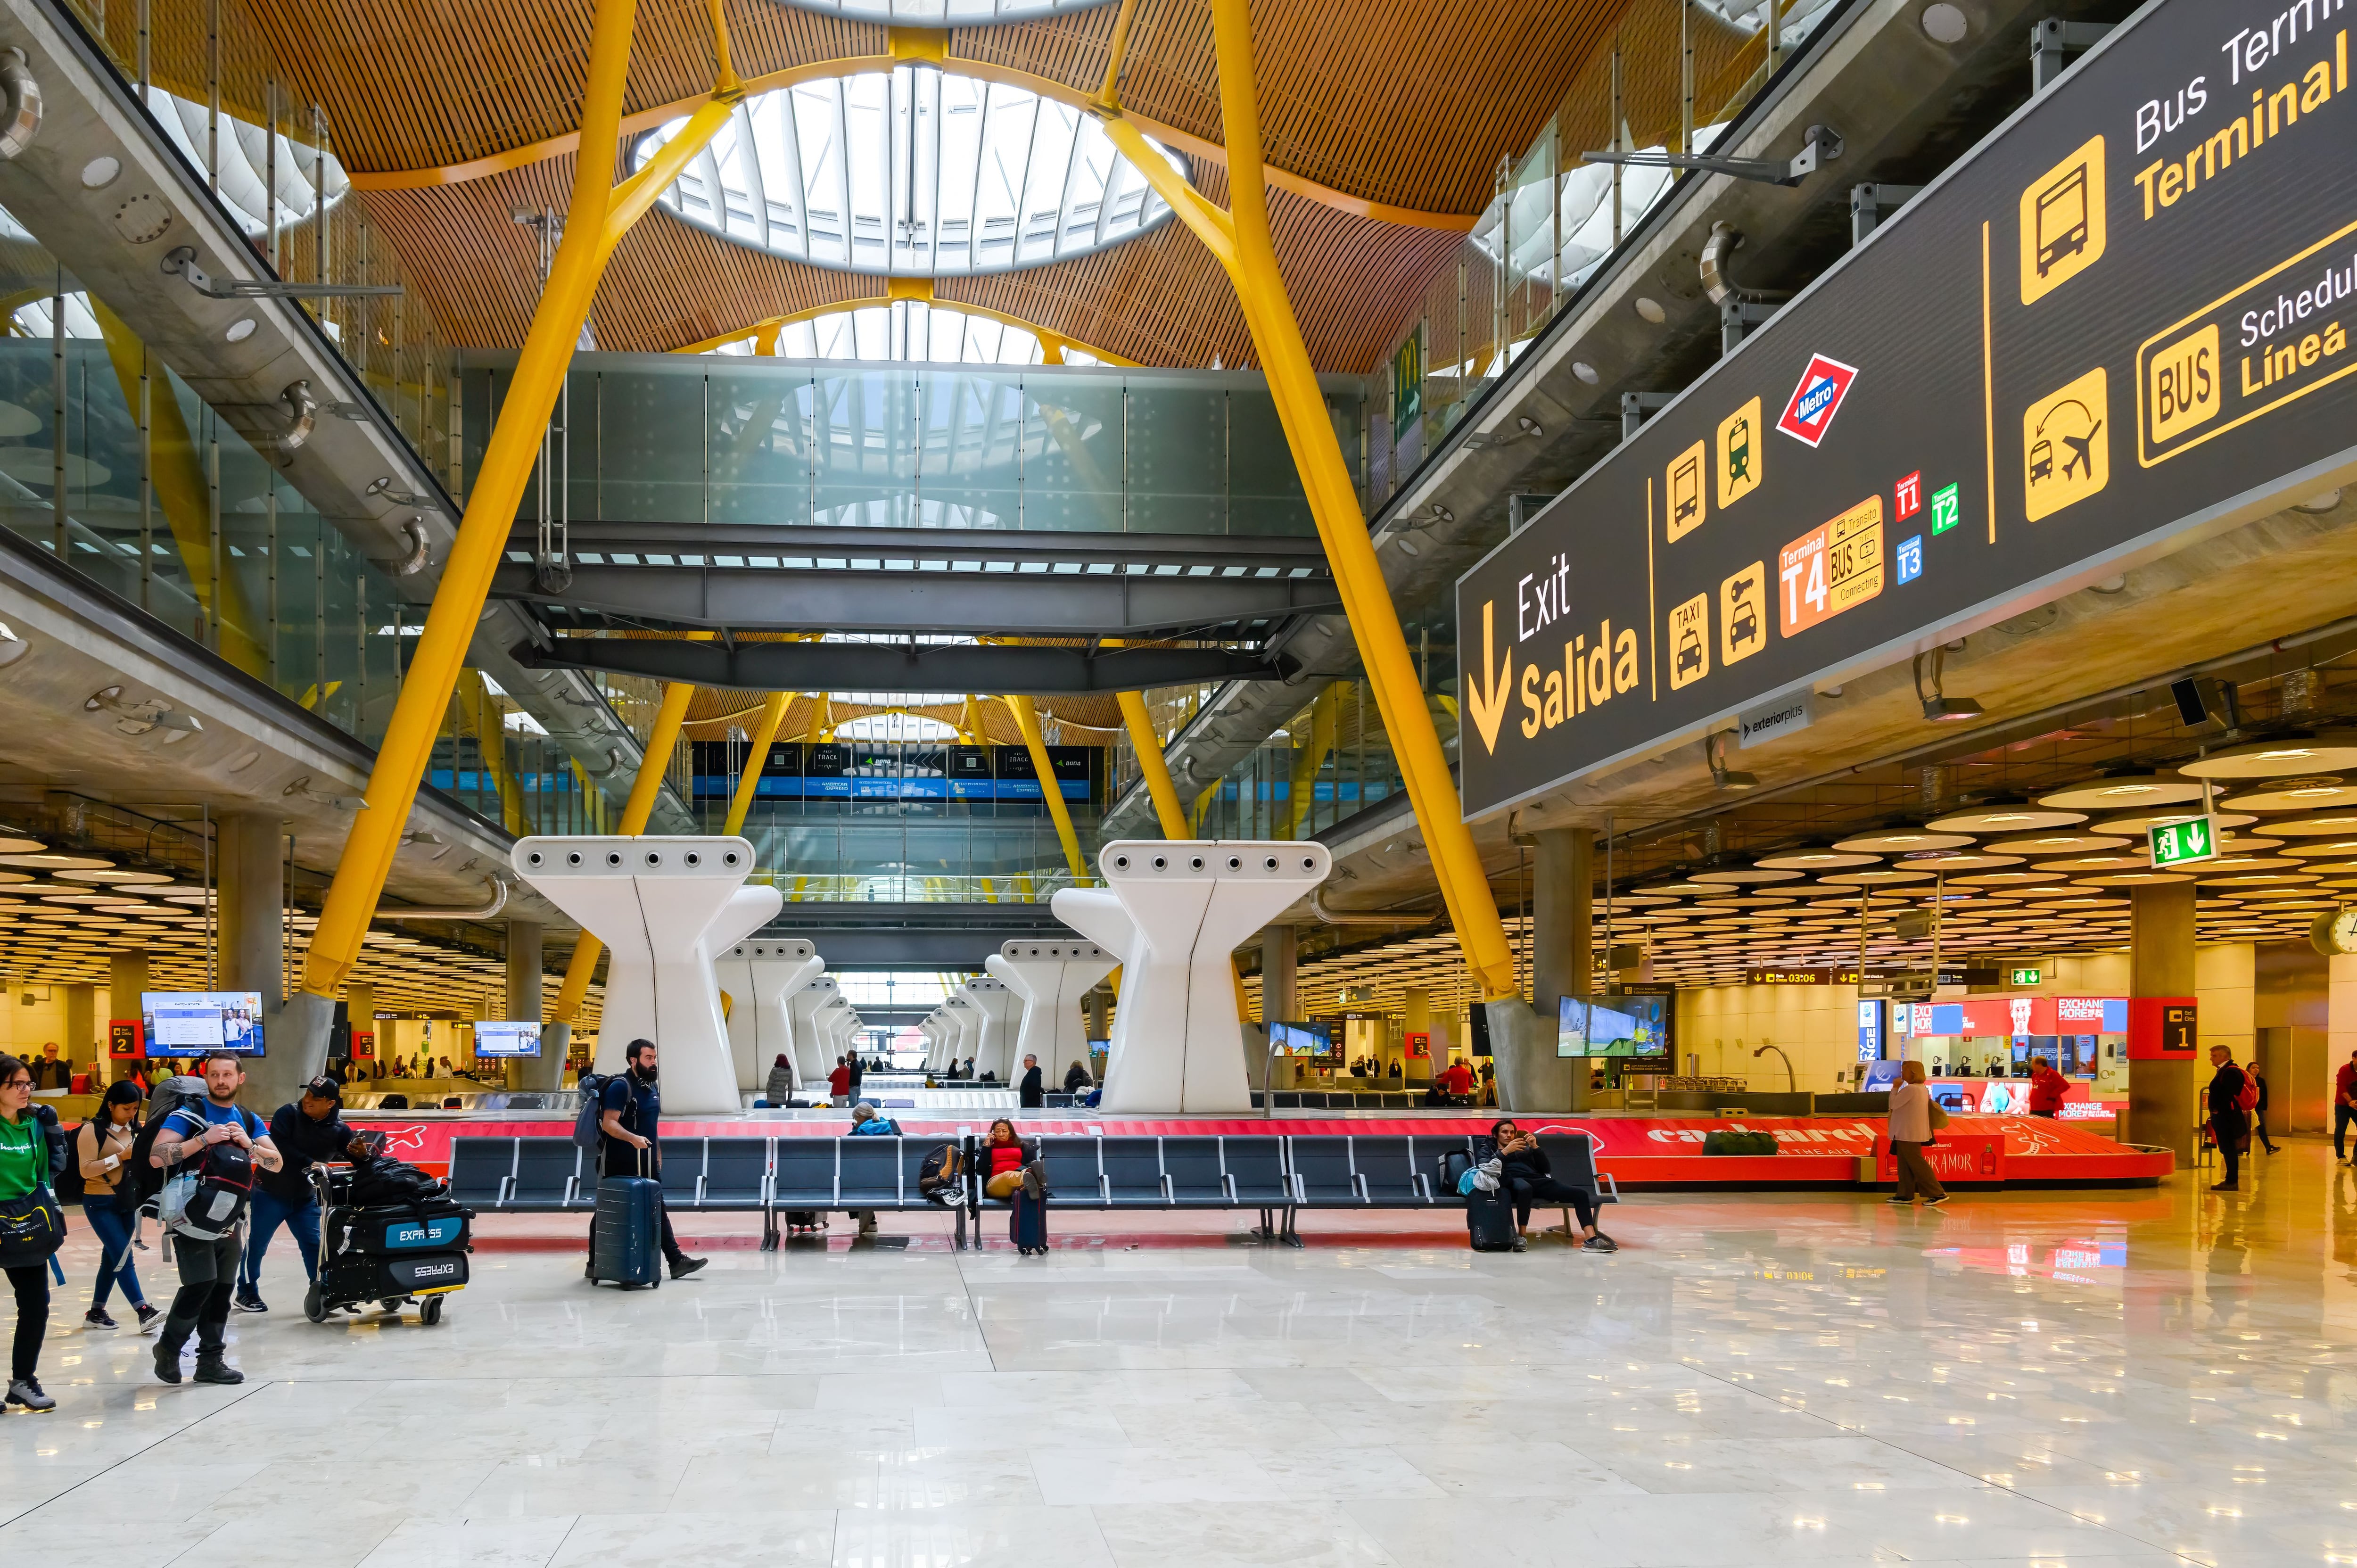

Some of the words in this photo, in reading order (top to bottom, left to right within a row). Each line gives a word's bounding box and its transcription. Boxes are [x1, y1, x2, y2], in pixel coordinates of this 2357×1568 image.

[2134, 29, 2347, 221] Terminal
[2137, 76, 2207, 154] Bus
[2241, 322, 2347, 397] Línea
[2159, 347, 2211, 423] BUS
[1799, 386, 1831, 419] Metro
[1897, 473, 1918, 492] Terminal
[1897, 483, 1919, 515] T1
[1933, 495, 1958, 529] T2
[1782, 531, 1824, 567] Terminal
[1831, 544, 1853, 583] BUS
[1898, 547, 1920, 578] T3
[1519, 553, 1570, 642] Exit
[1782, 553, 1827, 625] T4
[1841, 575, 1878, 601] Connecting
[1677, 602, 1700, 628] TAXI
[1521, 619, 1639, 739] Salida
[1753, 705, 1803, 732] exteriorplus
[1788, 974, 1800, 982] 03
[1803, 974, 1815, 982] 06
[2058, 999, 2104, 1008] EXCHANG
[2058, 1009, 2088, 1018] MORE
[1914, 1018, 1932, 1030] MOR
[2178, 1027, 2189, 1047] 1
[117, 1039, 126, 1051] 2
[365, 1045, 371, 1054] 3
[1417, 1045, 1424, 1054] 3
[1940, 1153, 1973, 1174] AMOR
[400, 1228, 442, 1241] EXPRSS
[415, 1263, 453, 1278] EXPRESS
